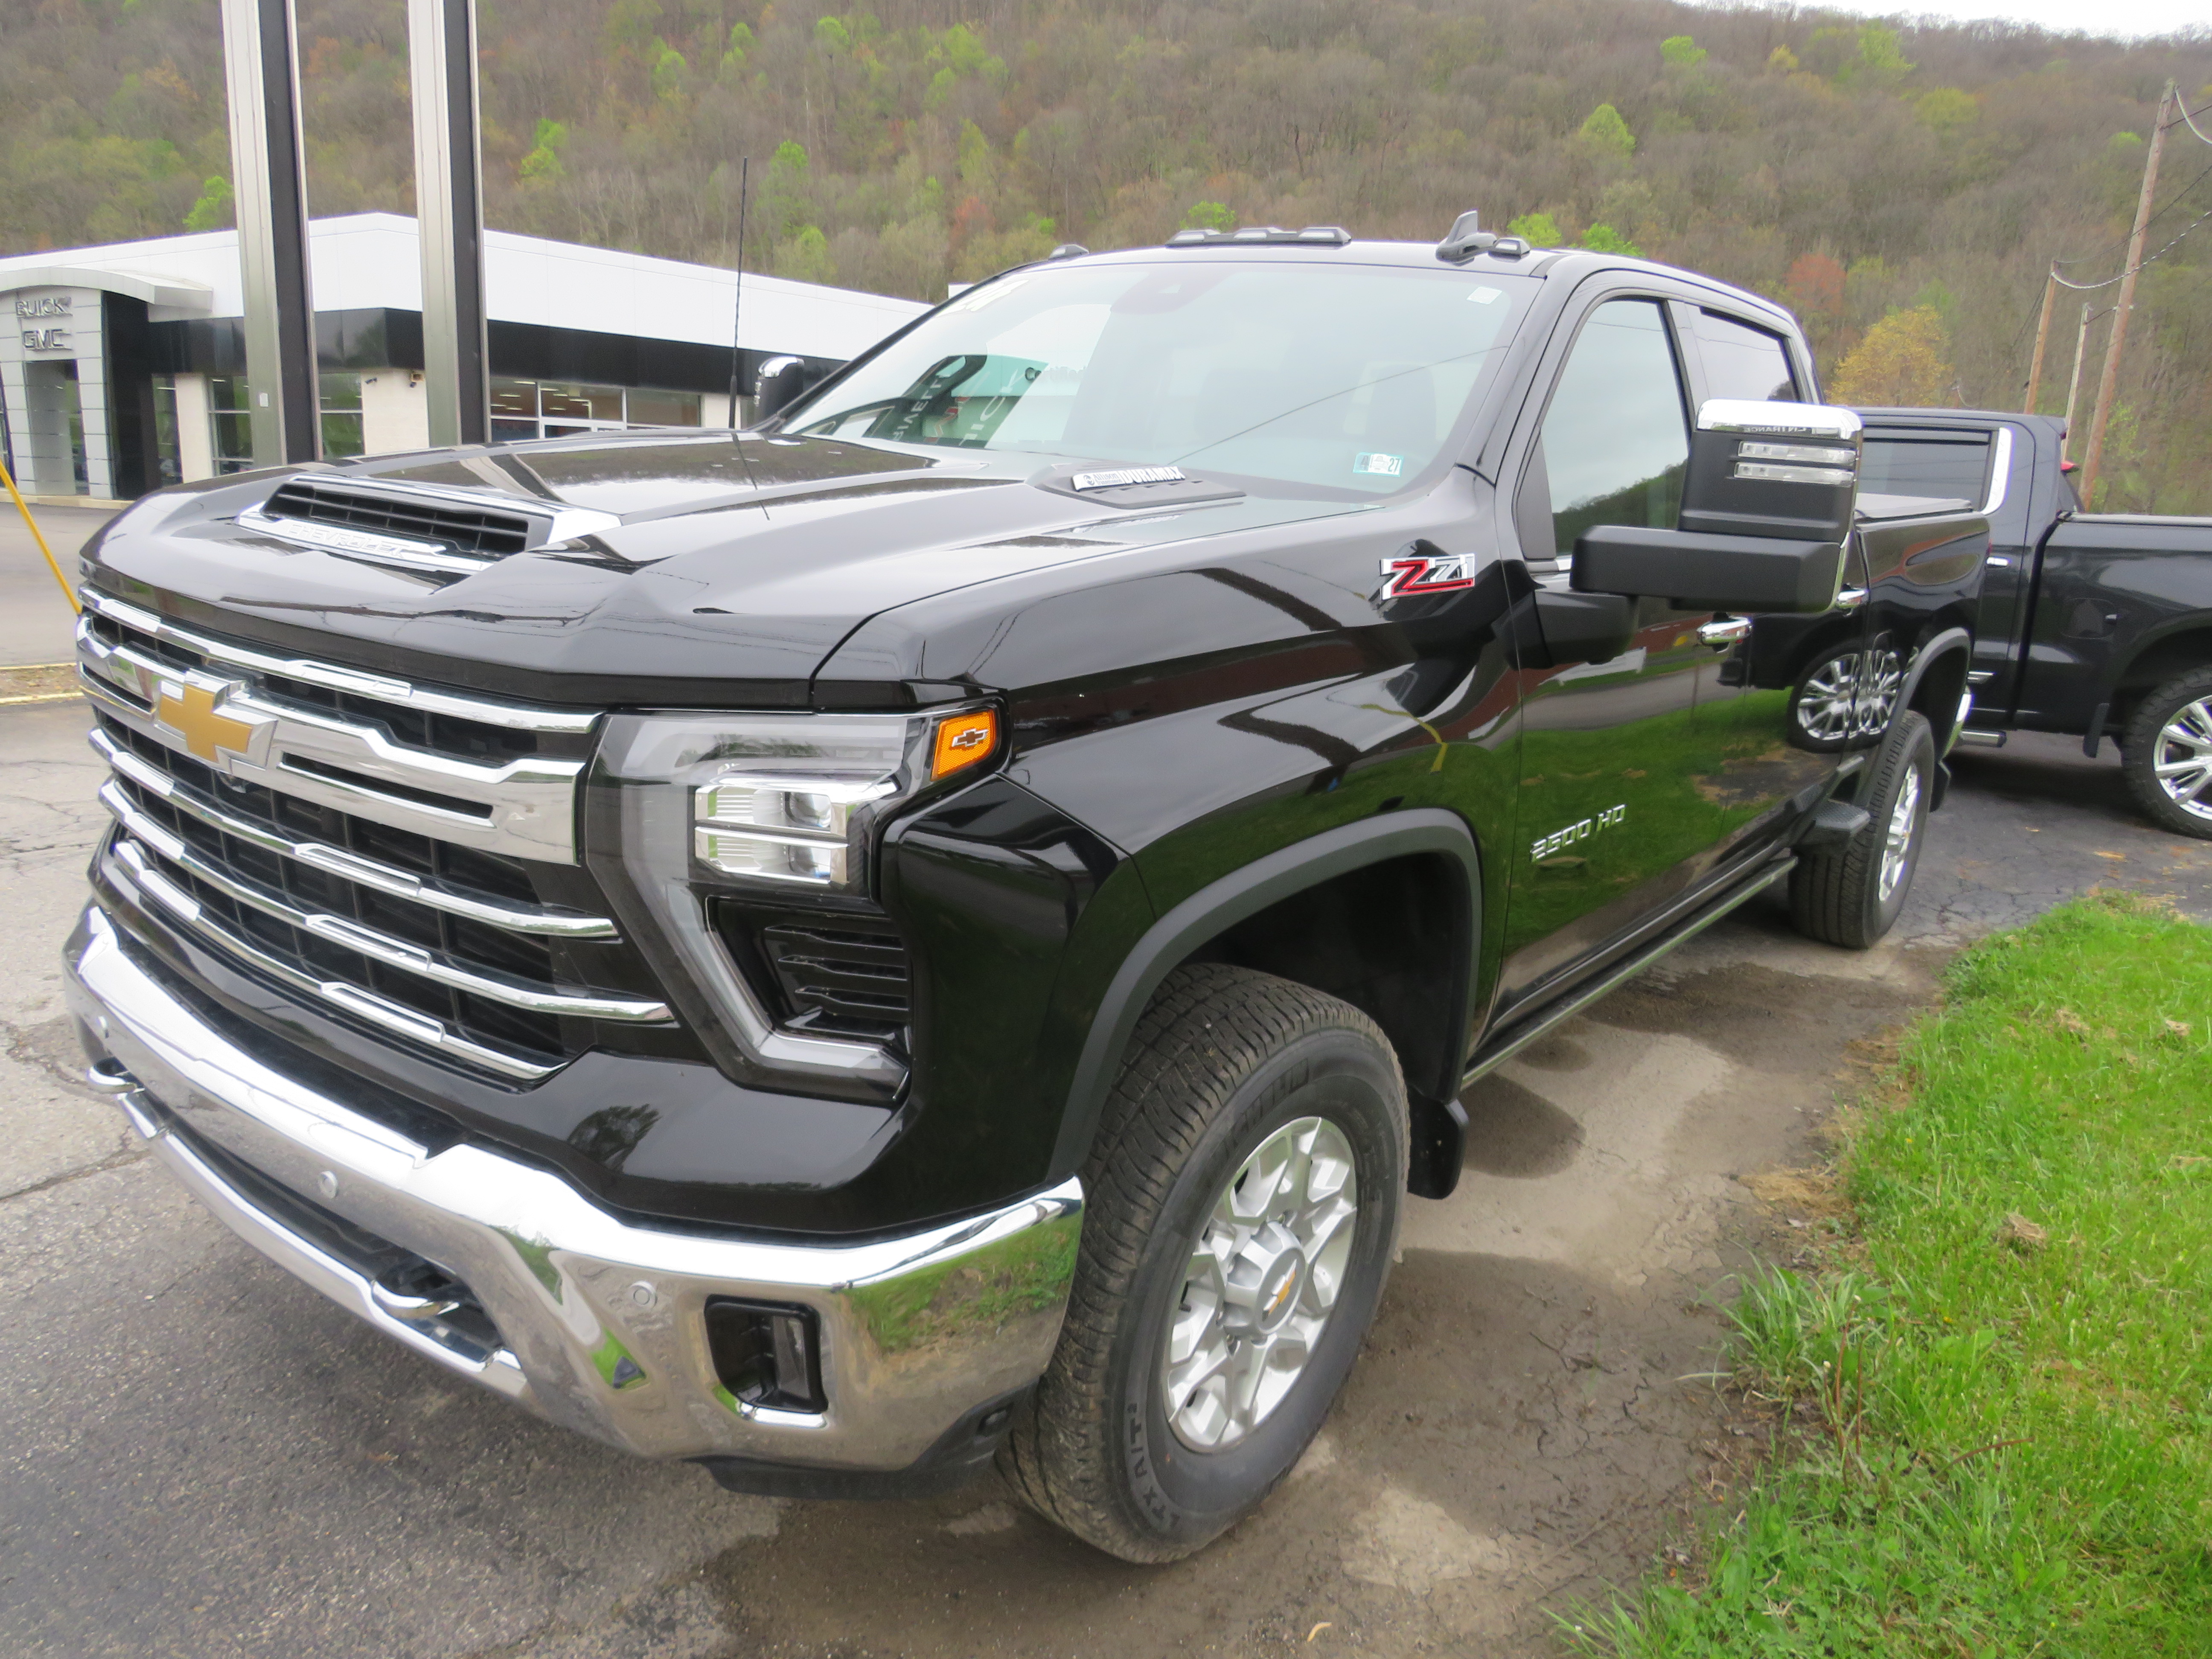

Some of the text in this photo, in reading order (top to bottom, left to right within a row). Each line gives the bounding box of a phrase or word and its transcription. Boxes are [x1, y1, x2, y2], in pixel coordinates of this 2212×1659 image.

[16, 298, 70, 316] BUICK
[22, 328, 64, 349] GMC
[1118, 466, 1186, 485] DURAMAX
[1388, 457, 1400, 474] 27
[1093, 473, 1120, 481] Allison
[288, 523, 410, 558] CHEVROLET
[1380, 553, 1476, 600] Z71
[1530, 804, 1627, 863] 2500 HD
